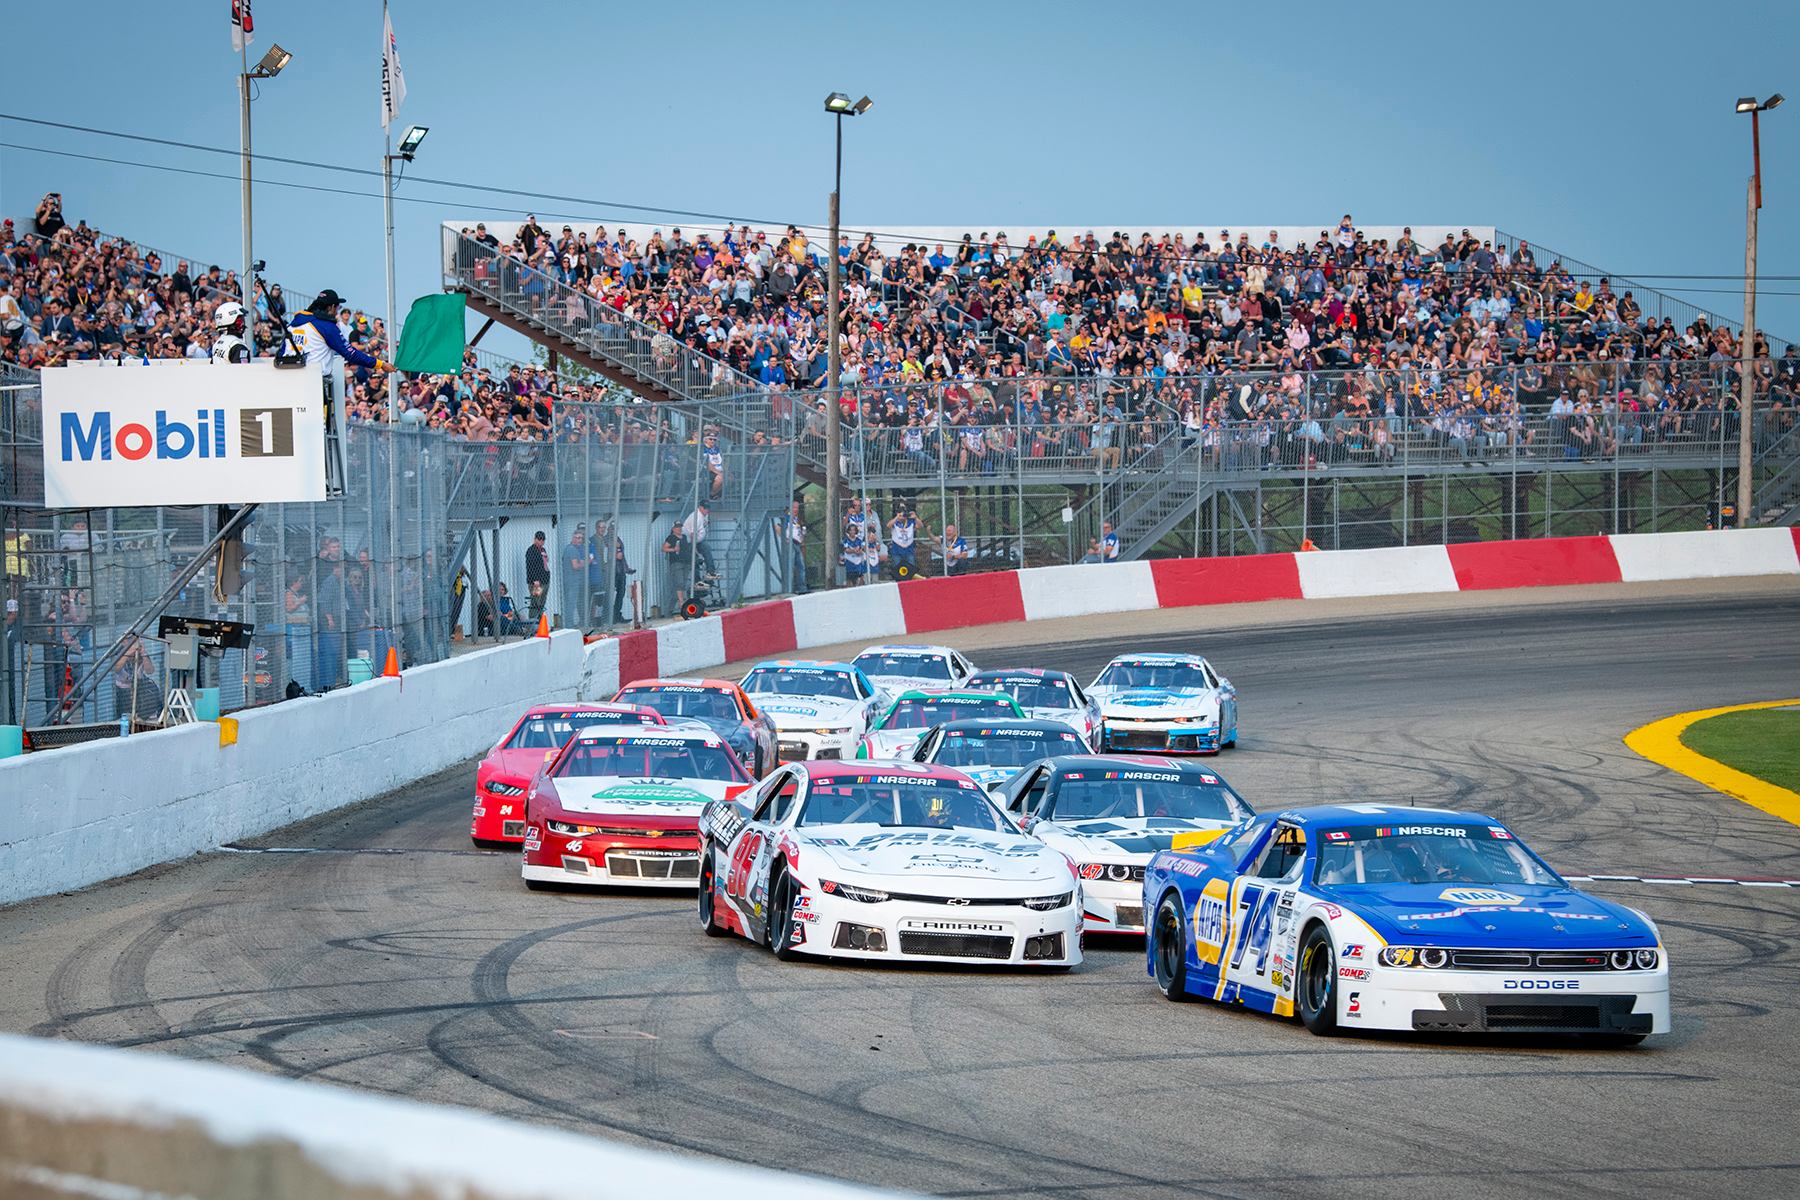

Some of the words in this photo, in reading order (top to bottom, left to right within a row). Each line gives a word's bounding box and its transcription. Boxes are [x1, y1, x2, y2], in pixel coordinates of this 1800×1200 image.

[60, 408, 226, 461] Mobil
[255, 411, 274, 454] 1
[575, 712, 622, 720] NASCAR
[996, 729, 1044, 737] NASCAR
[633, 738, 686, 747] NASCAR
[876, 776, 937, 787] NASCAR
[1123, 772, 1181, 782] NASCAR
[499, 805, 513, 816] 24
[1398, 826, 1467, 838] NASCAR
[566, 840, 583, 853] 46
[1082, 864, 1103, 879] 47
[822, 881, 837, 893] 96
[1451, 890, 1516, 901] NAPA
[907, 920, 1004, 932] CAMARO
[1198, 898, 1224, 944] NAPA
[1231, 883, 1281, 976] 74
[1341, 944, 1364, 957] JE
[1393, 949, 1415, 965] 74
[1339, 967, 1364, 978] COMP
[1504, 980, 1580, 989] DODGE
